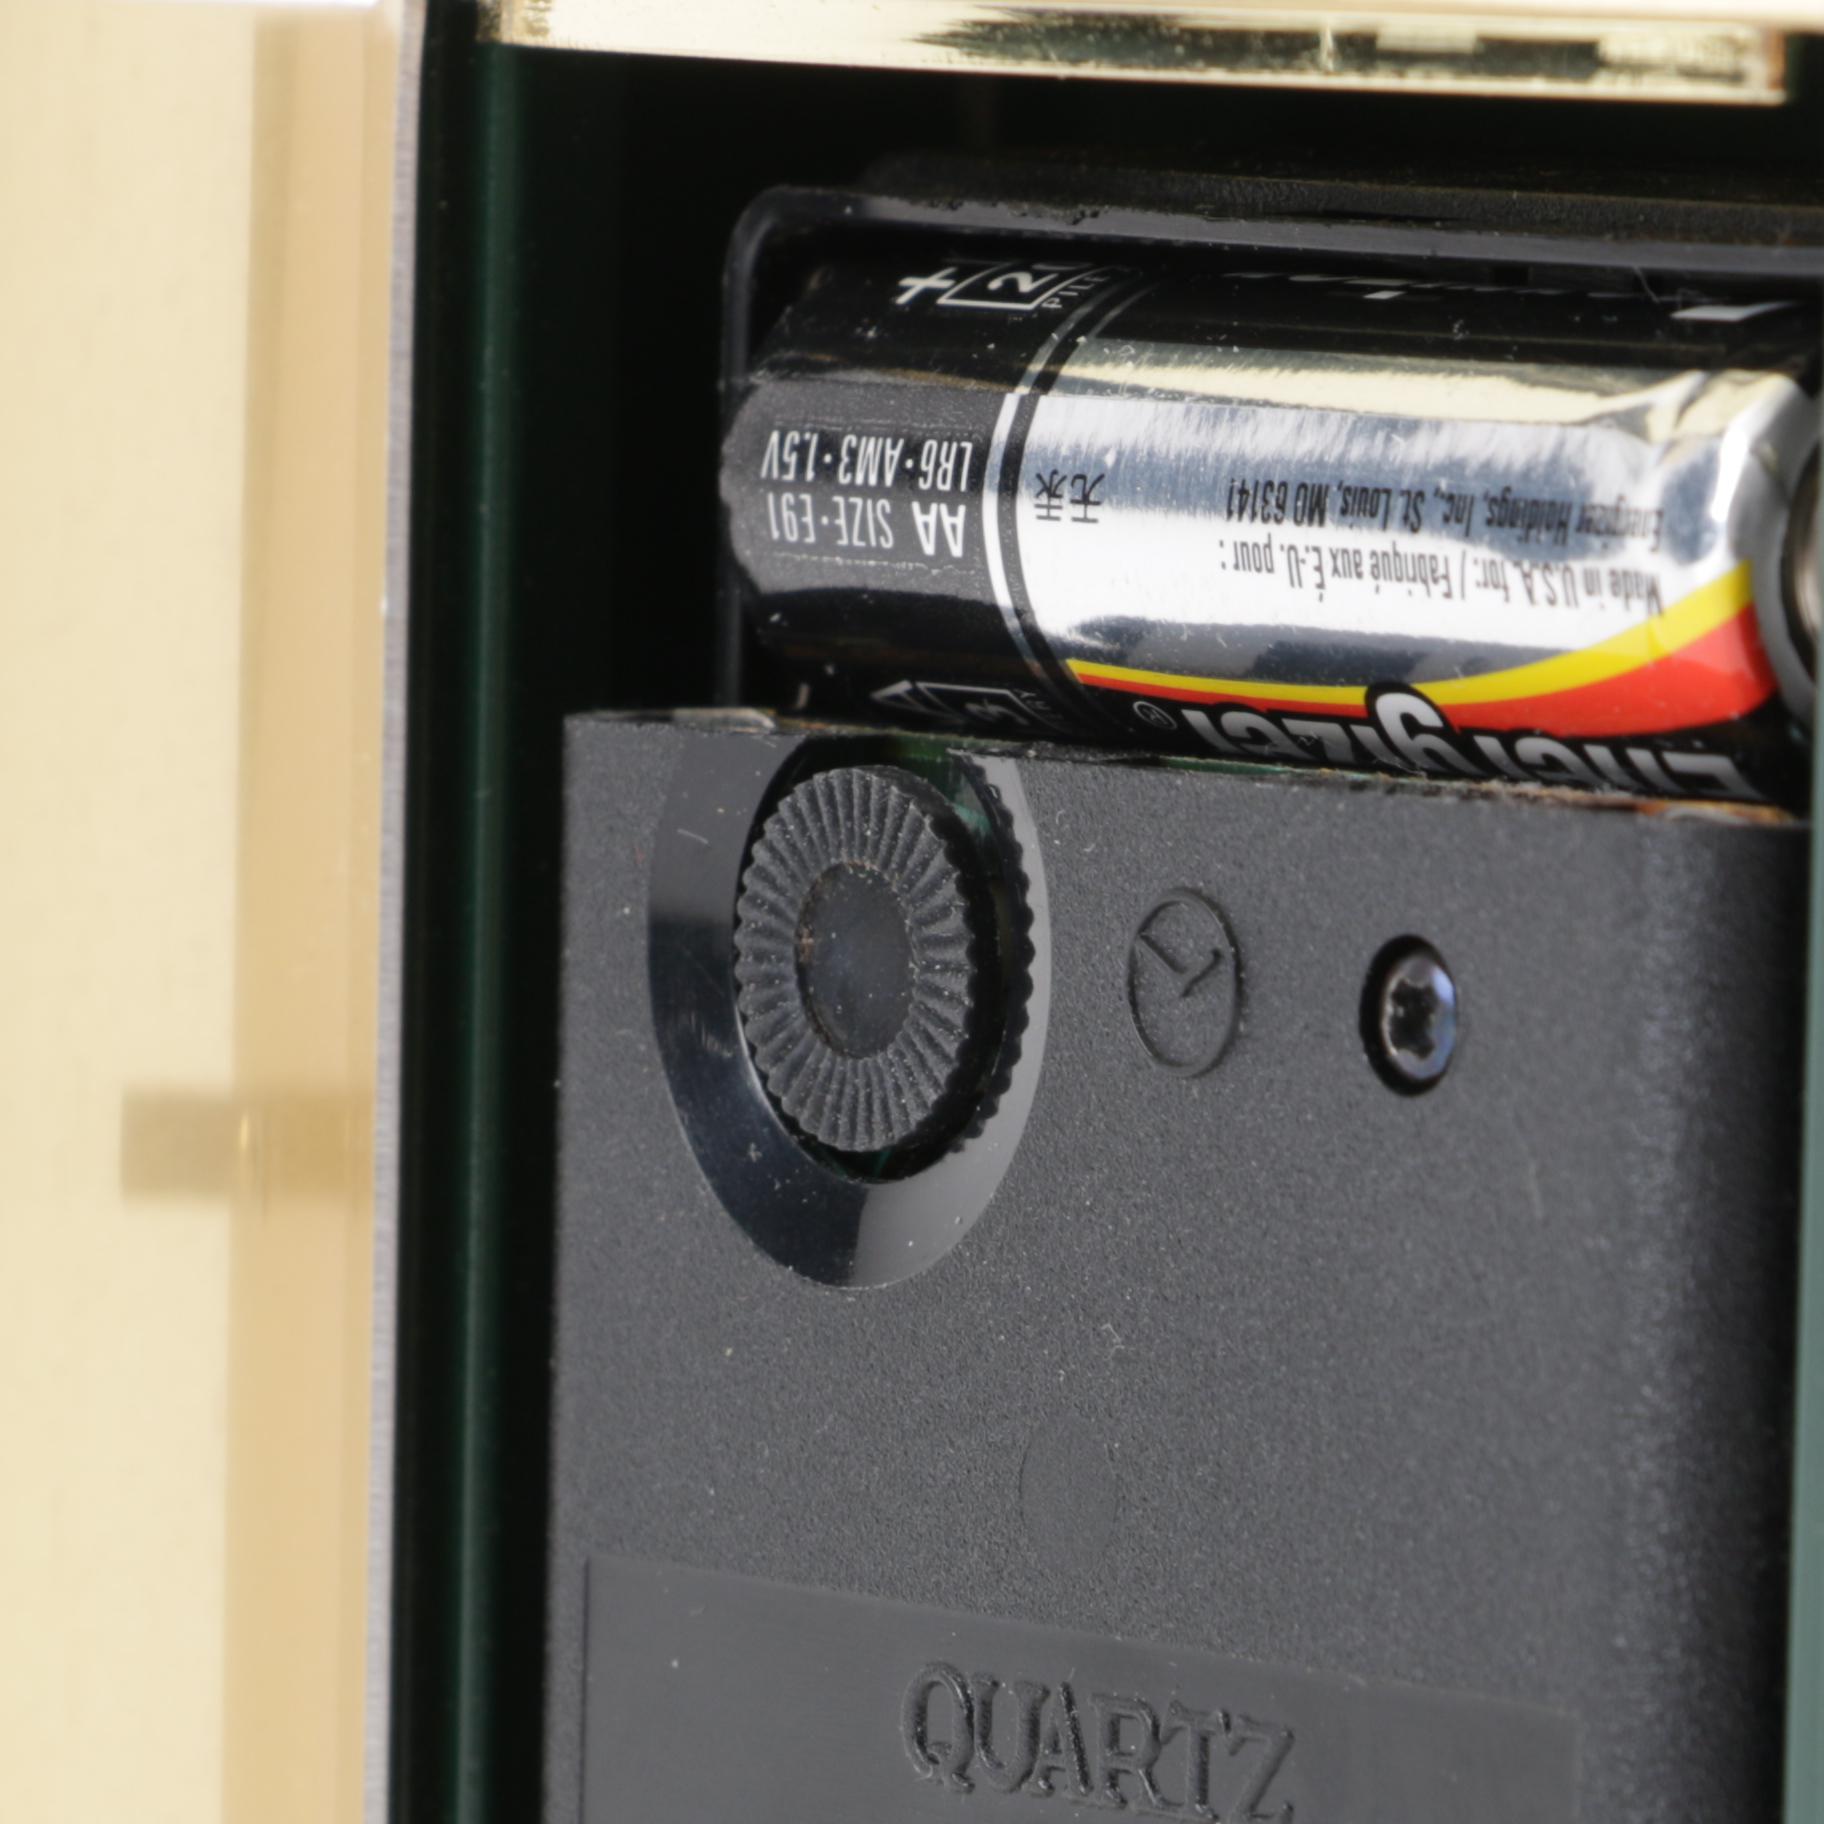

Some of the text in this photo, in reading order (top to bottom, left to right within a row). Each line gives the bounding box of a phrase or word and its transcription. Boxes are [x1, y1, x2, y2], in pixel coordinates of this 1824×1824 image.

[1034, 470, 1105, 524] 无汞
[1226, 478, 1288, 525] 63141
[1293, 482, 1330, 528] MO
[1336, 480, 1392, 532] Louis,
[1399, 489, 1425, 534] St.
[1483, 486, 1573, 548] Holdings,
[912, 501, 966, 558] AA
[1329, 548, 1364, 580] aux
[1369, 541, 1453, 598] Fabriqué
[1474, 559, 1509, 603] for:
[1513, 561, 1579, 608] U.S.A.
[1583, 568, 1602, 608] in
[1610, 570, 1662, 616] Made
